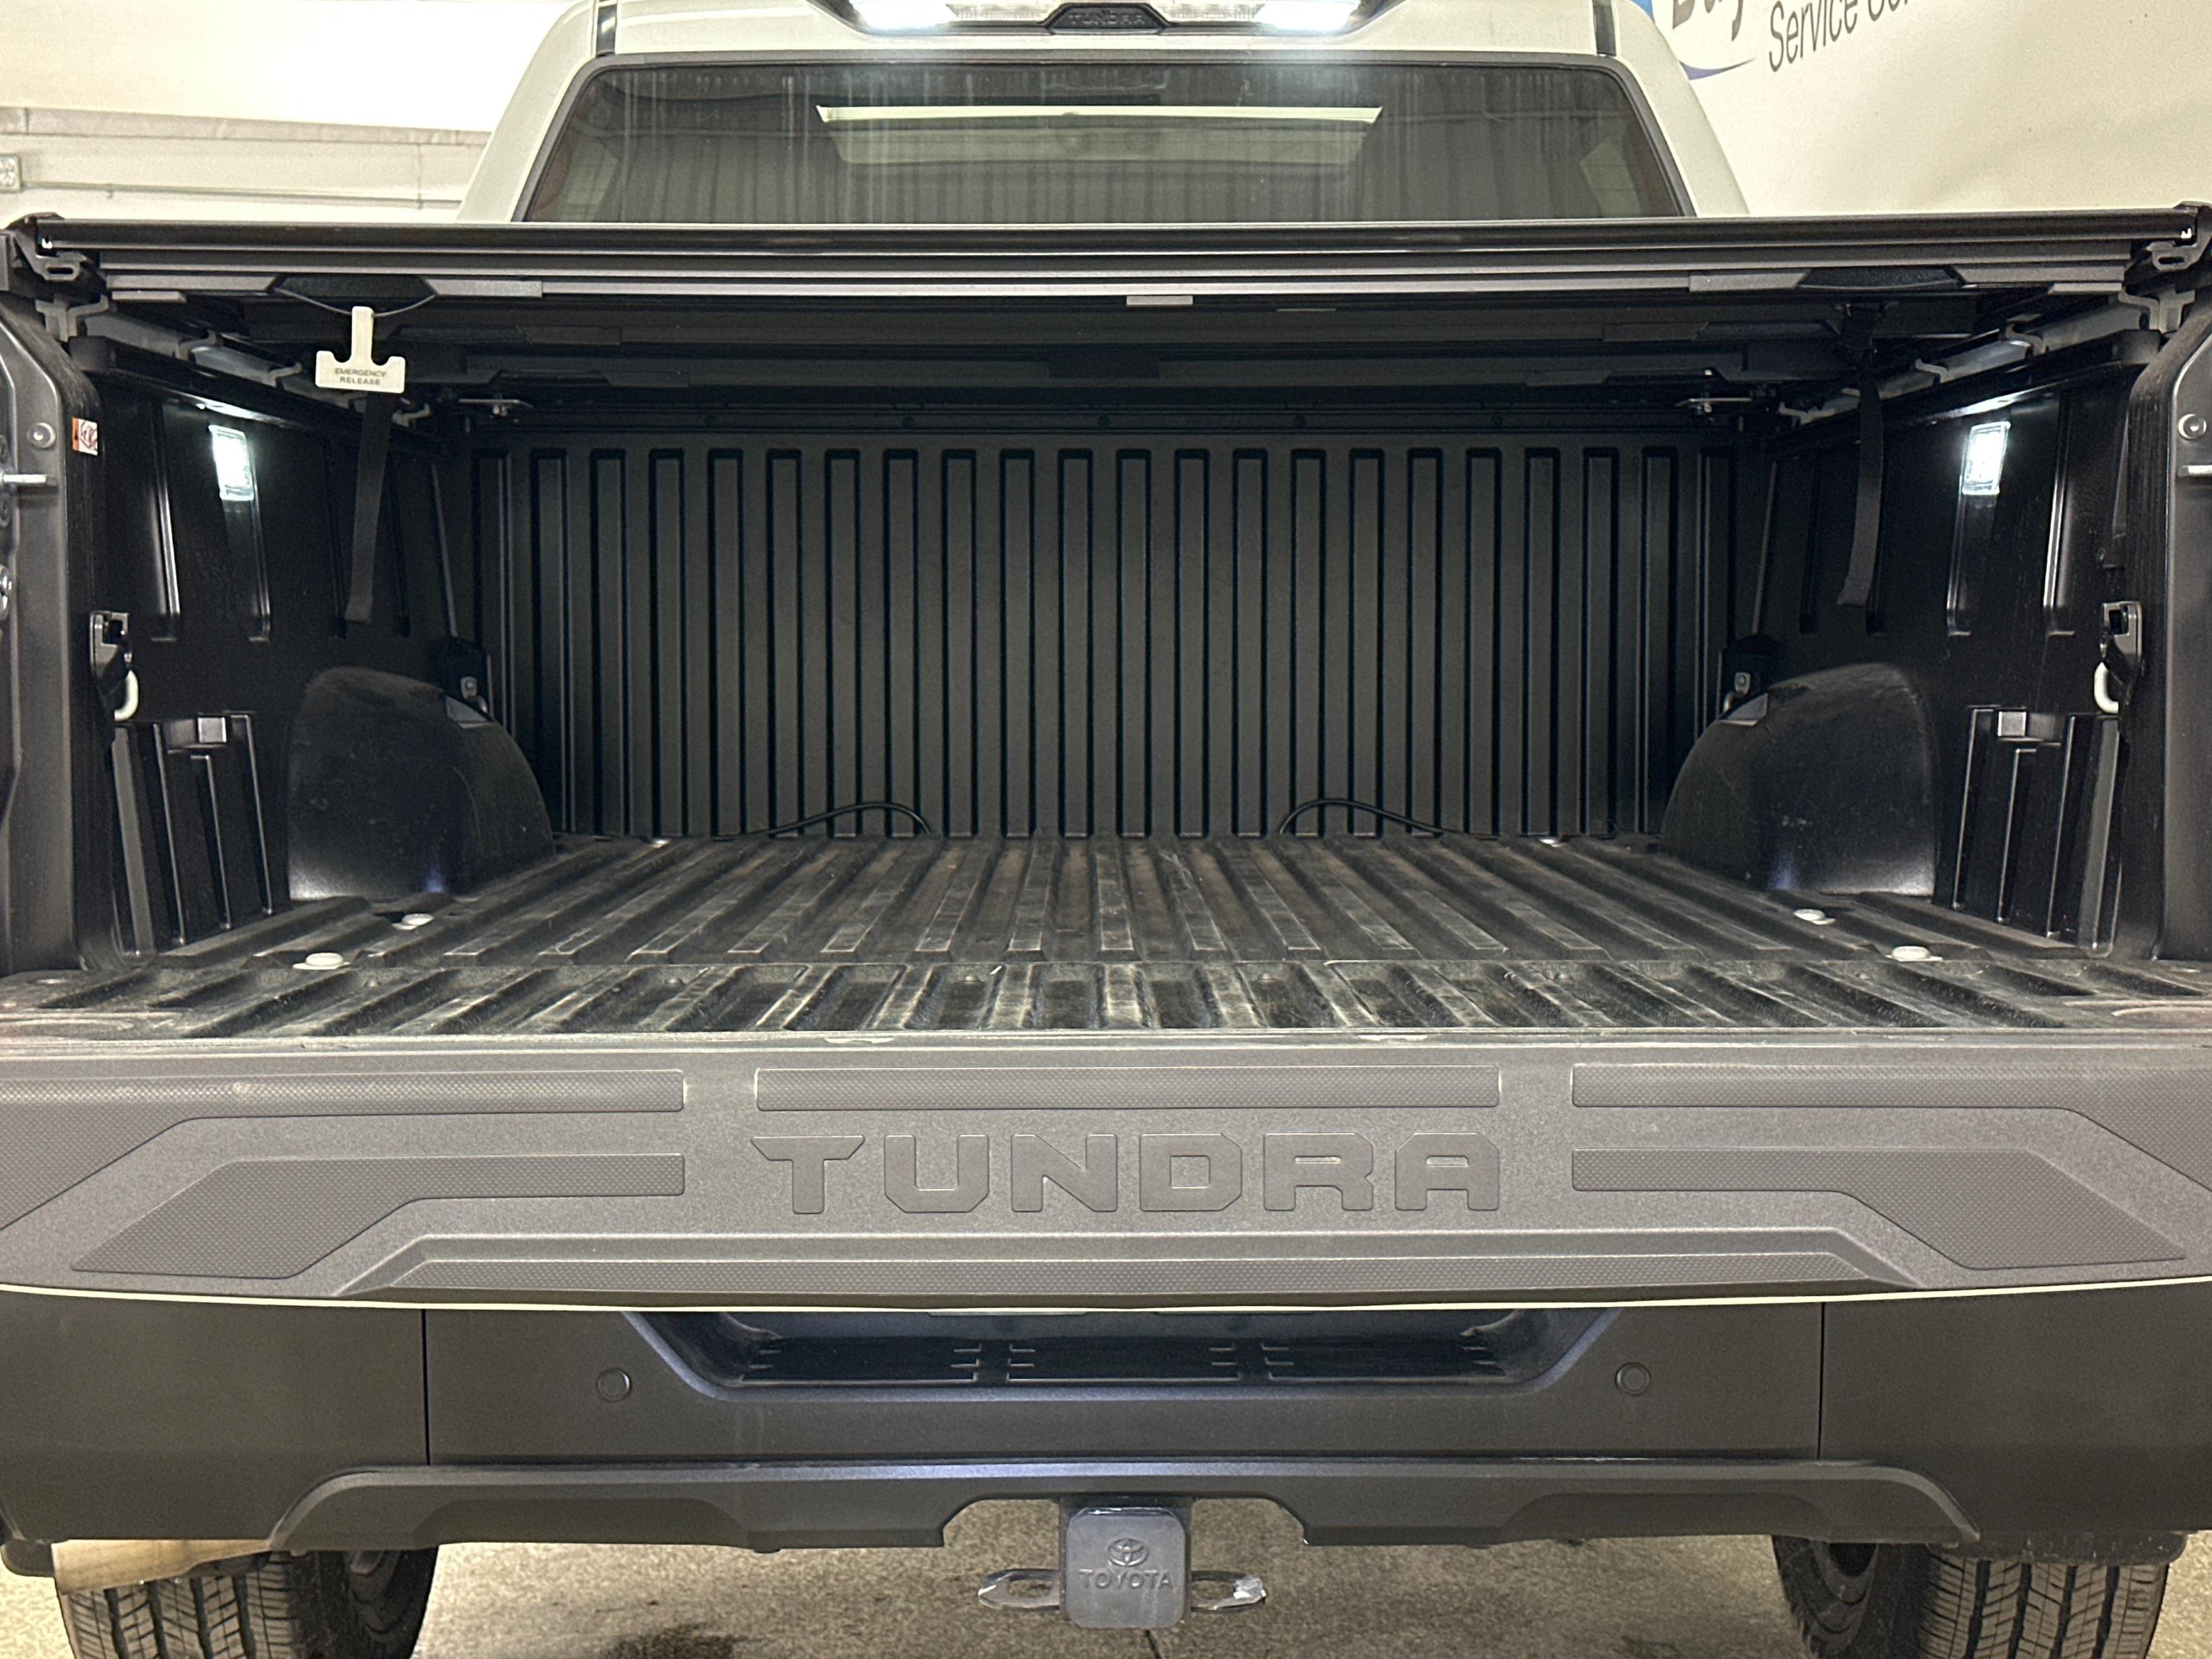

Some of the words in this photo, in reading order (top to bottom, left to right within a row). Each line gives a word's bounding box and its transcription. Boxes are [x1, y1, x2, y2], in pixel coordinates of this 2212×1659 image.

[335, 368, 387, 377] EMERGENCY
[340, 377, 380, 385] RELEASE
[751, 1131, 1501, 1215] TUNDRA
[1079, 1568, 1174, 1589] TOYOTA
